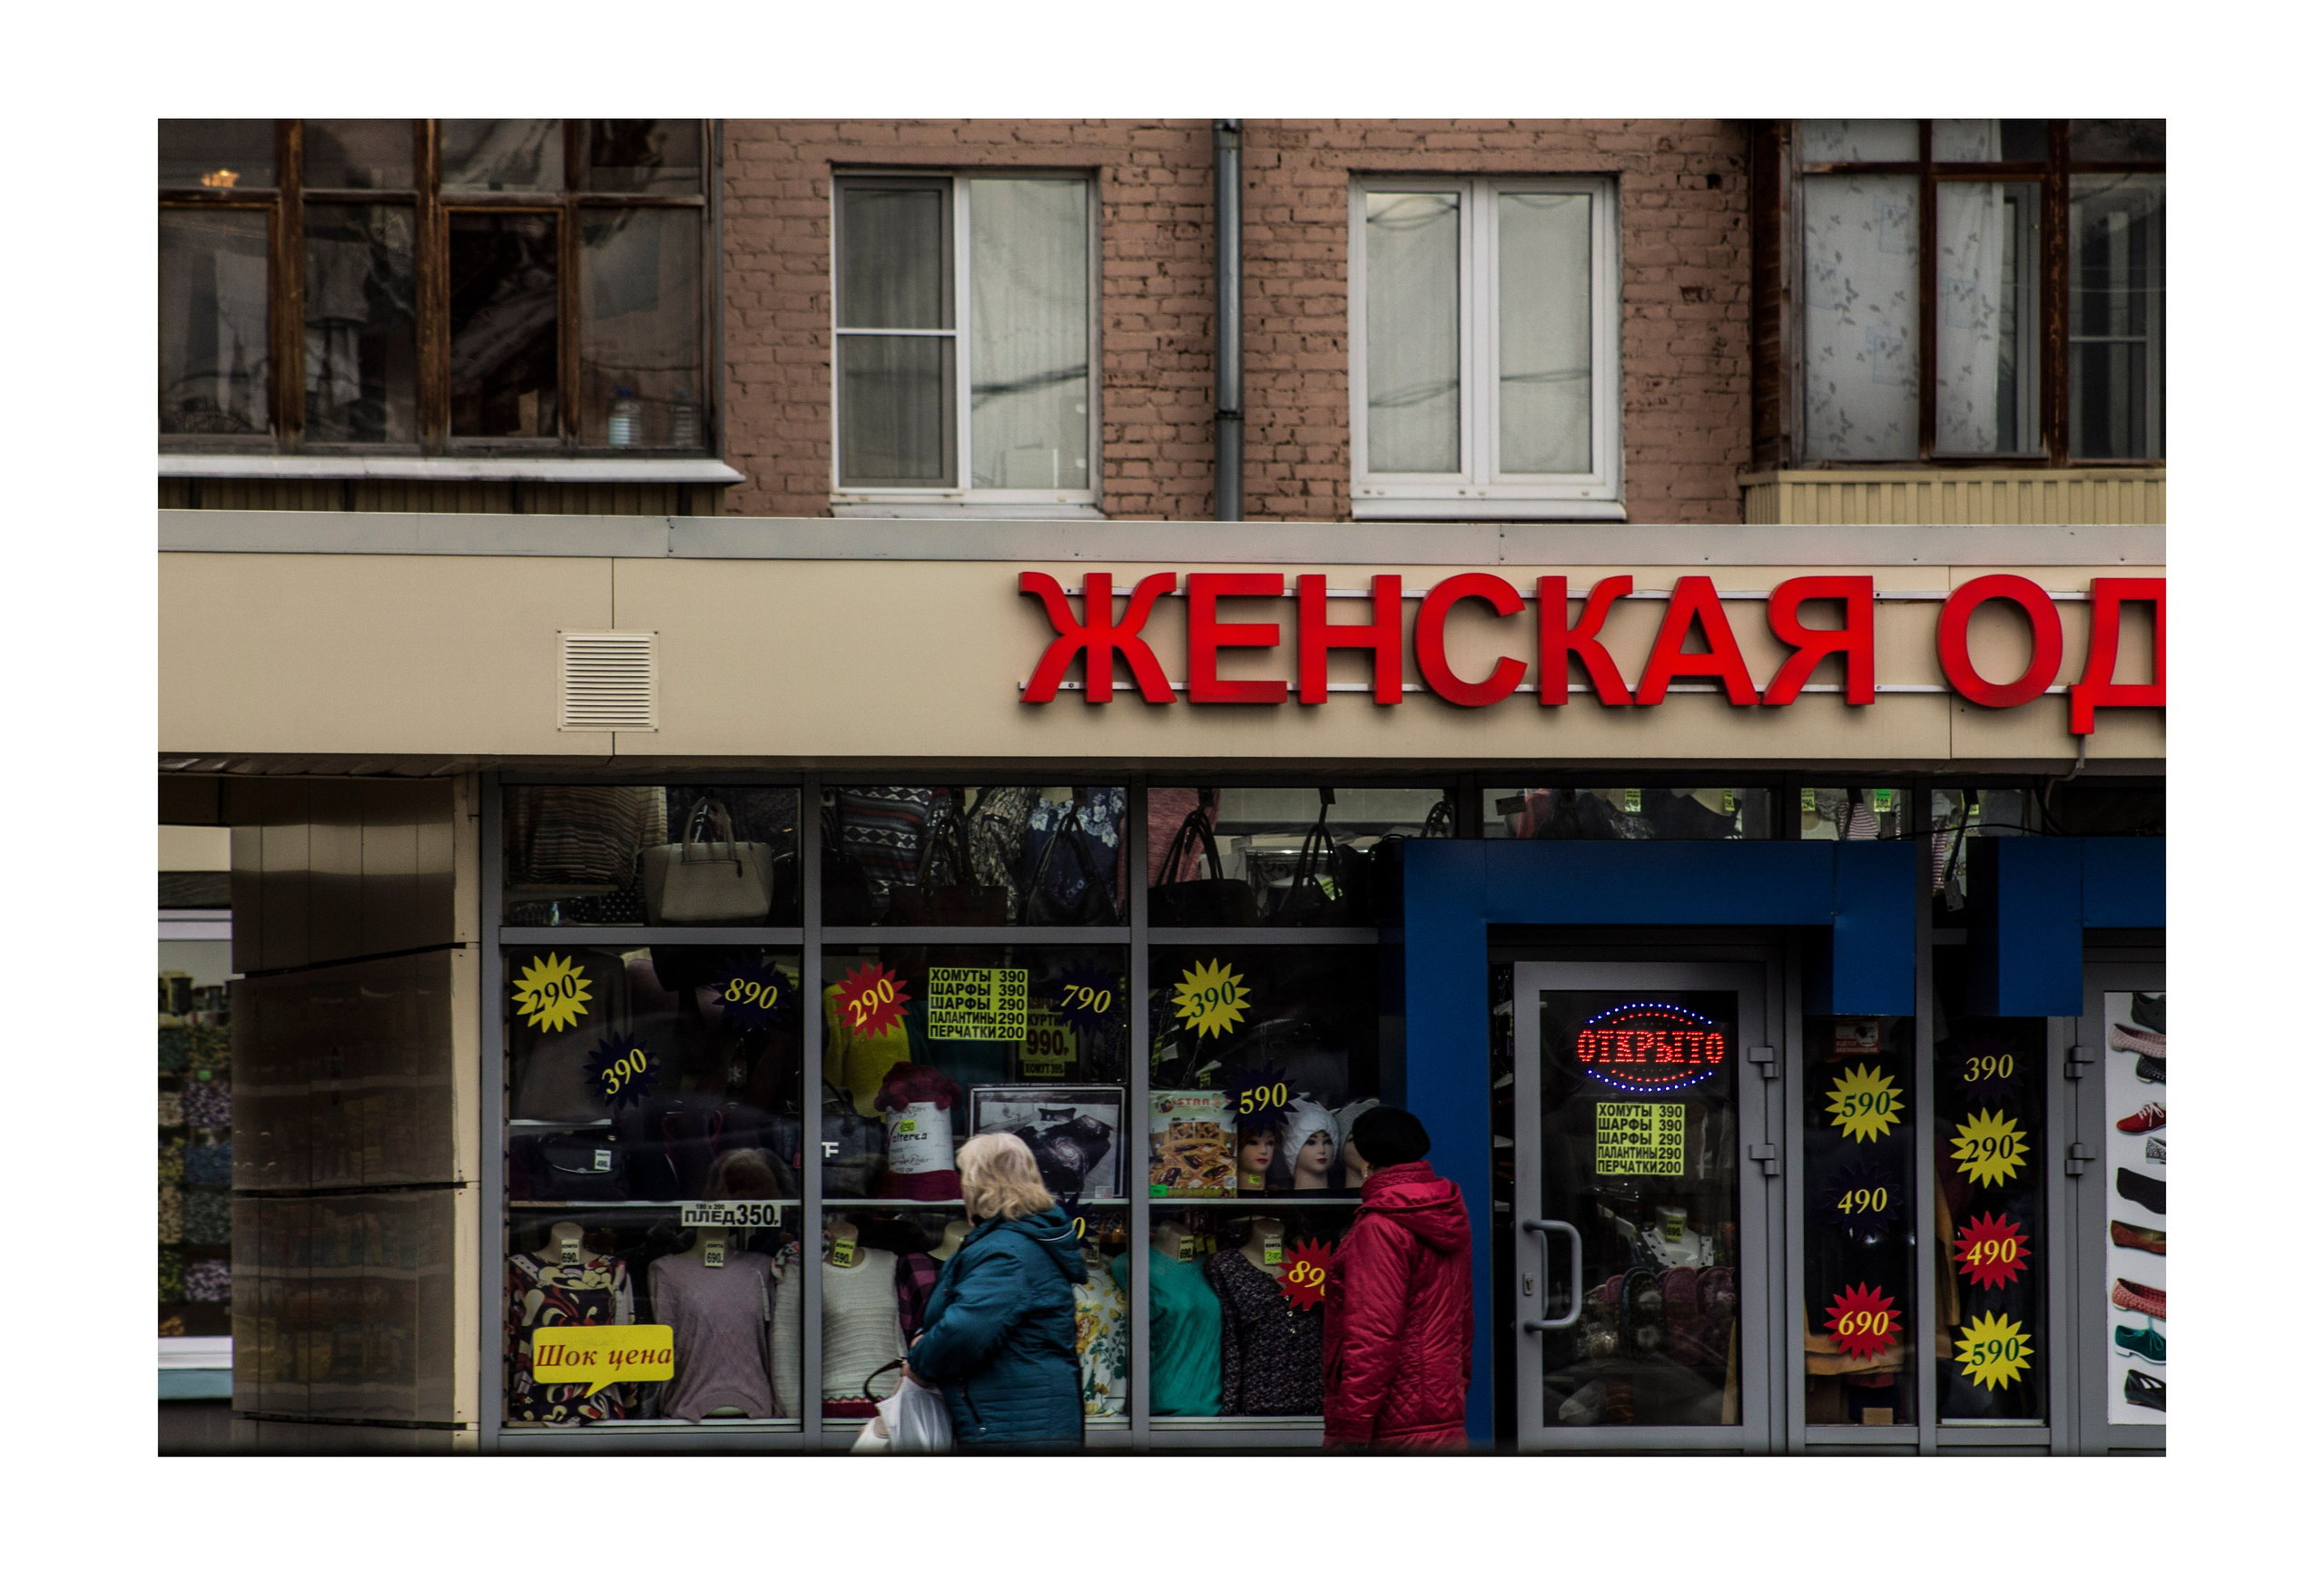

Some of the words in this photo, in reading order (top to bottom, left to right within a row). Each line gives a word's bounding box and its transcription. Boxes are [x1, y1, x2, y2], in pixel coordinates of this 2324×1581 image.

[1019, 571, 1876, 707] ЖЕНСКАЯ
[931, 969, 991, 982] ХОМУТЫ
[999, 971, 1026, 983] 390
[528, 974, 576, 1016] 290
[724, 978, 778, 1008] 890
[849, 978, 895, 1026] 290
[931, 984, 990, 997] ШАРФЫ
[999, 985, 1026, 997] 390
[1060, 984, 1111, 1013] 790
[1189, 981, 1236, 1018] 390
[931, 998, 990, 1011] ШАРФЫ
[999, 999, 1025, 1011] 290
[930, 1012, 998, 1025] ПАЛАНТИНЫ
[999, 1013, 1025, 1025] 290
[1028, 1014, 1068, 1026] КУРТК
[930, 1026, 997, 1039] ПЕРЧАТКИ
[998, 1026, 1024, 1039] 200
[1577, 1030, 1725, 1064] ОТКРЫТО
[602, 1048, 647, 1094] 390
[1964, 1054, 2014, 1082] 390
[1239, 1083, 1287, 1115] 590
[1599, 1105, 1652, 1117] ХОМУТЫ
[1659, 1105, 1682, 1117] 390
[1841, 1091, 1891, 1118] 590
[1598, 1118, 1651, 1131] ШАРФЫ
[1659, 1119, 1682, 1132] 390
[1598, 1132, 1652, 1145] ШАРФЫ
[1659, 1134, 1682, 1145] 290
[1598, 1146, 1658, 1159] ПАЛАНТИНЫ
[1659, 1147, 1681, 1160] 290
[1965, 1135, 2014, 1164] 290
[1598, 1160, 1658, 1173] ПЕРЧАТКИ
[1658, 1161, 1681, 1173] 200
[1837, 1187, 1887, 1214] 490
[684, 1211, 735, 1225] ПЛЕД
[1966, 1238, 2017, 1266] 490
[1288, 1261, 1325, 1297] 89
[1837, 1310, 1889, 1336] 690
[536, 1344, 597, 1368] Шок
[608, 1348, 673, 1372] цена
[1971, 1337, 2020, 1366] 590
